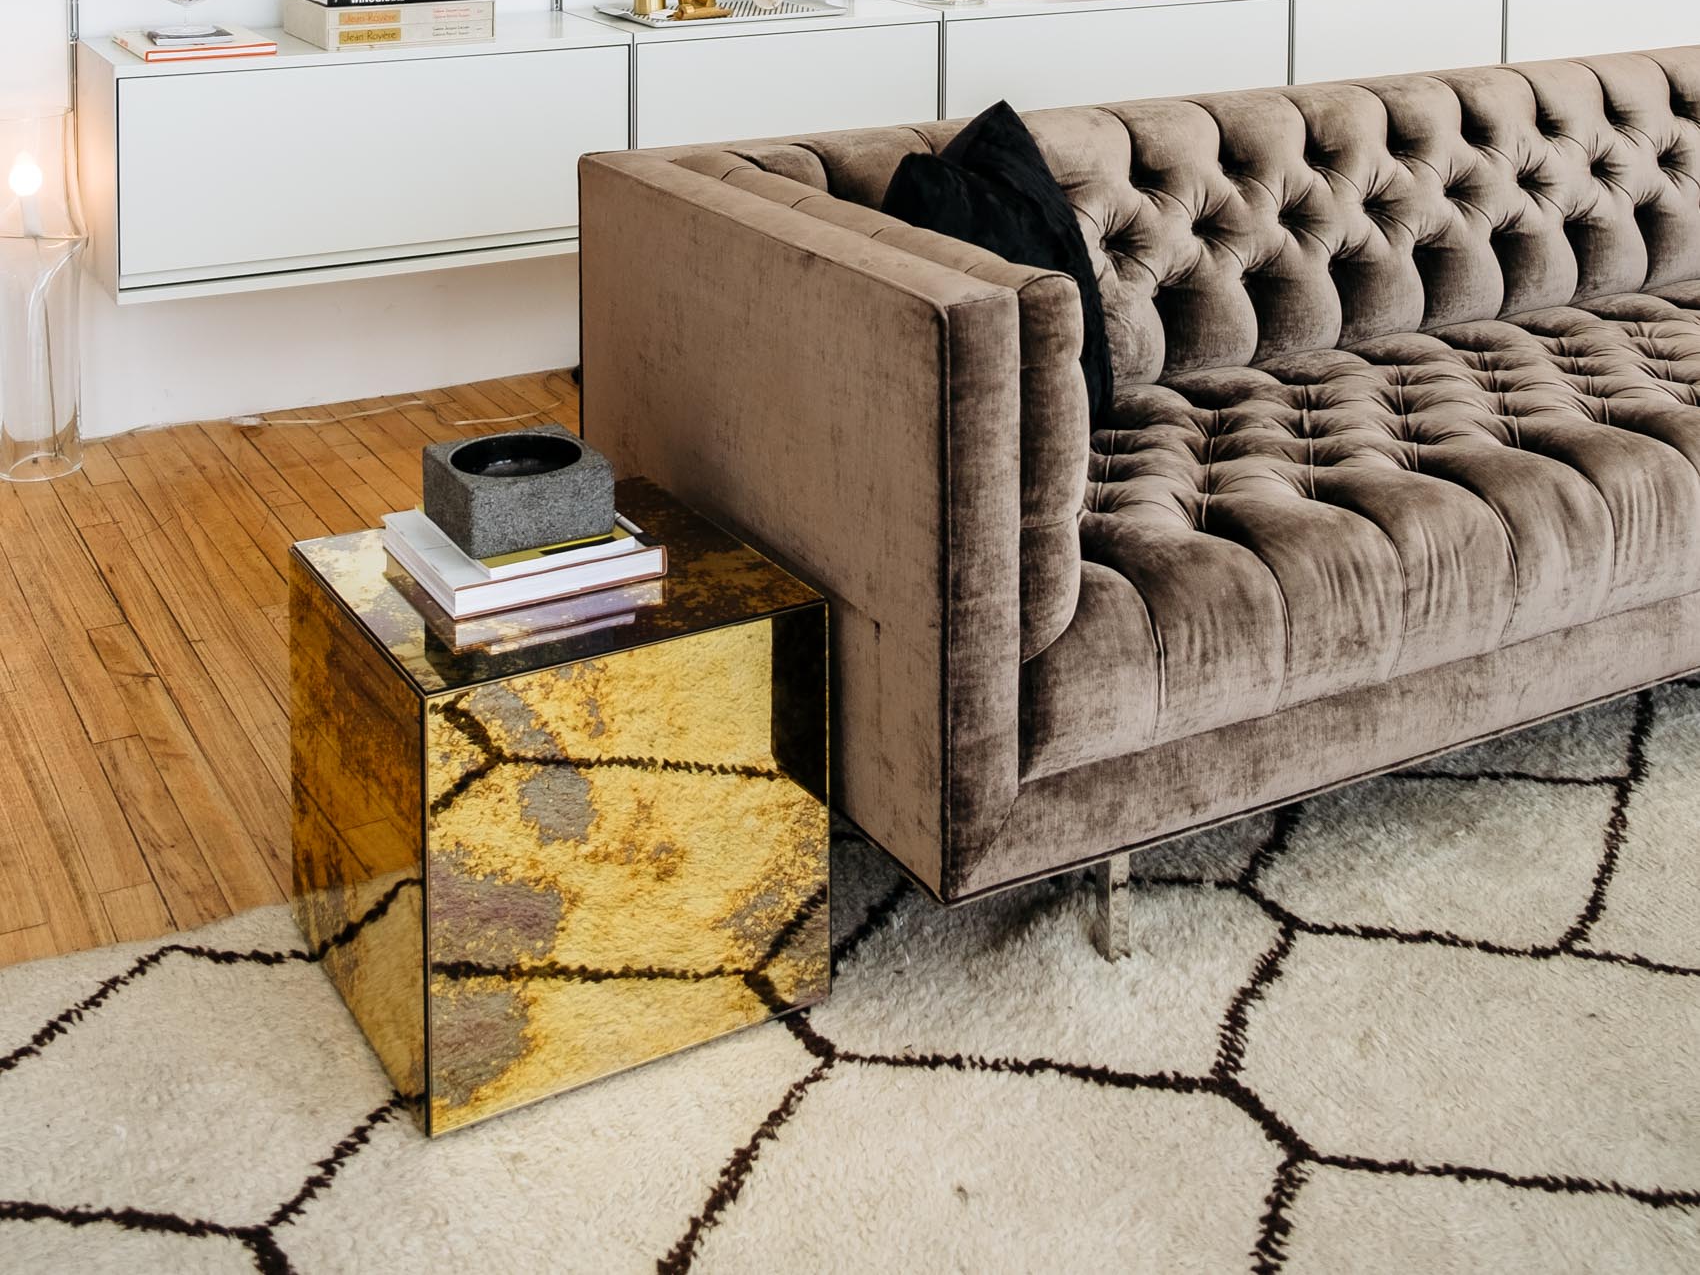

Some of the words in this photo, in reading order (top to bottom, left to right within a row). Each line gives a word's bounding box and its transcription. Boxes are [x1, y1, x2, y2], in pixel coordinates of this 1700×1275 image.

[343, 13, 363, 24] Jean
[343, 31, 364, 43] Jean
[365, 29, 397, 41] Royère
